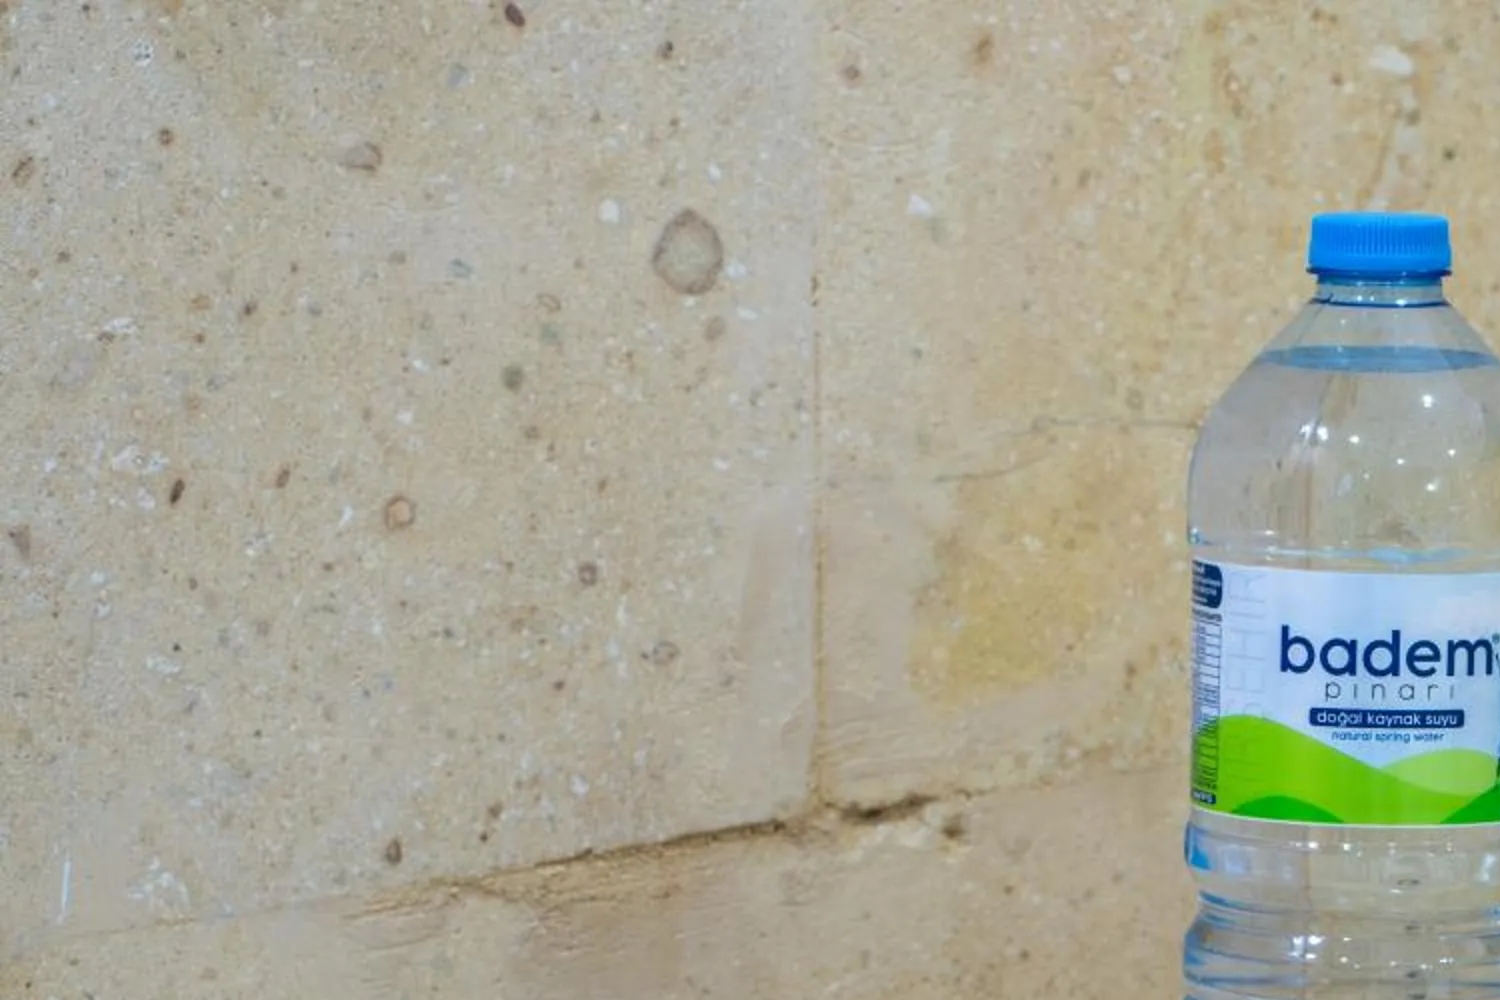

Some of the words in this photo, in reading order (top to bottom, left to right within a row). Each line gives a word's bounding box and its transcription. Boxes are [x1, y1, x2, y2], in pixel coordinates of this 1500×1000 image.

[1279, 624, 1493, 677] badem
[1316, 710, 1363, 728] doğal
[1367, 711, 1421, 727] kaynak
[1425, 713, 1458, 727] suyu
[1331, 730, 1373, 741] natural
[1375, 731, 1411, 743] spring
[1413, 732, 1445, 742] water
